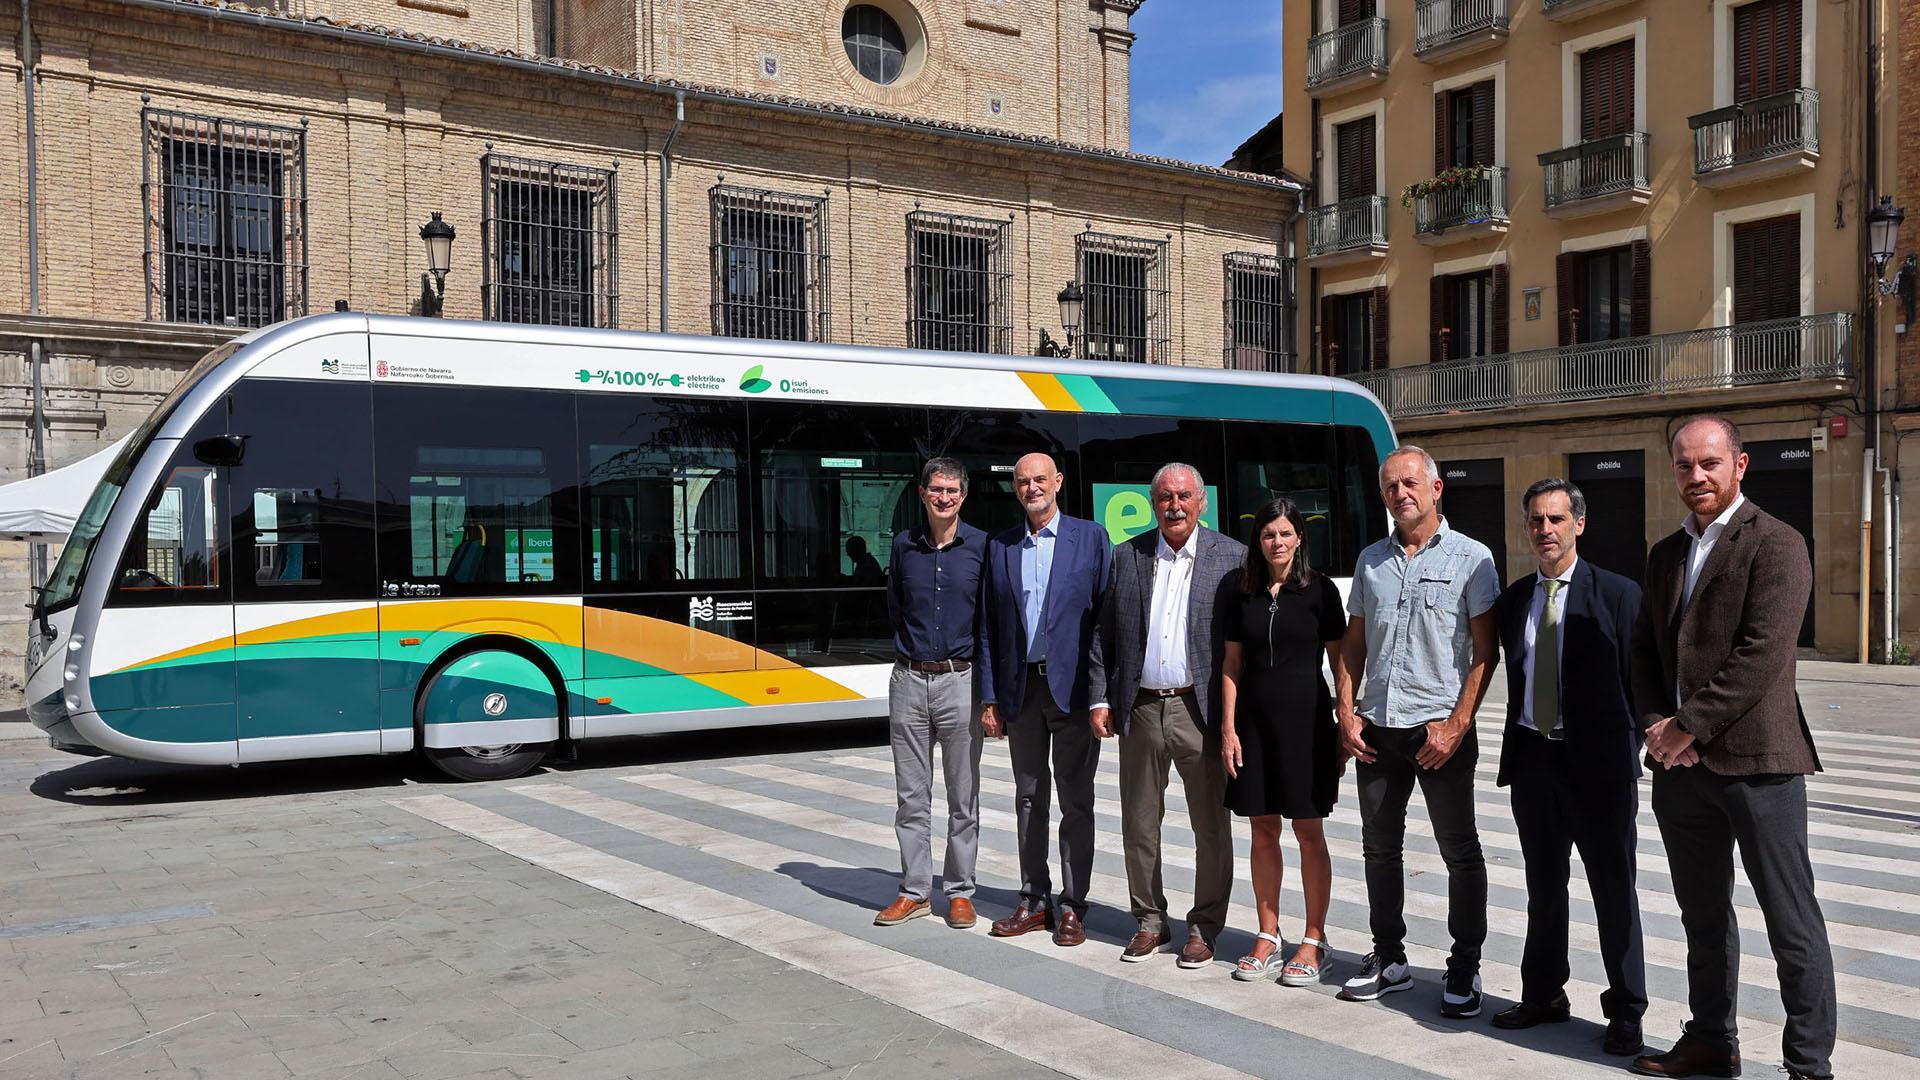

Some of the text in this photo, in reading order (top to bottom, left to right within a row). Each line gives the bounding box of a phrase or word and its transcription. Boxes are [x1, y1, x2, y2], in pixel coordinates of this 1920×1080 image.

[687, 374, 726, 383] elektrikoa
[791, 379, 808, 387] isuri
[780, 379, 791, 393] 0
[792, 387, 829, 395] emisiones
[1780, 449, 1811, 459] ehbildu
[1596, 461, 1621, 470] ehbildu
[401, 581, 441, 596] tram
